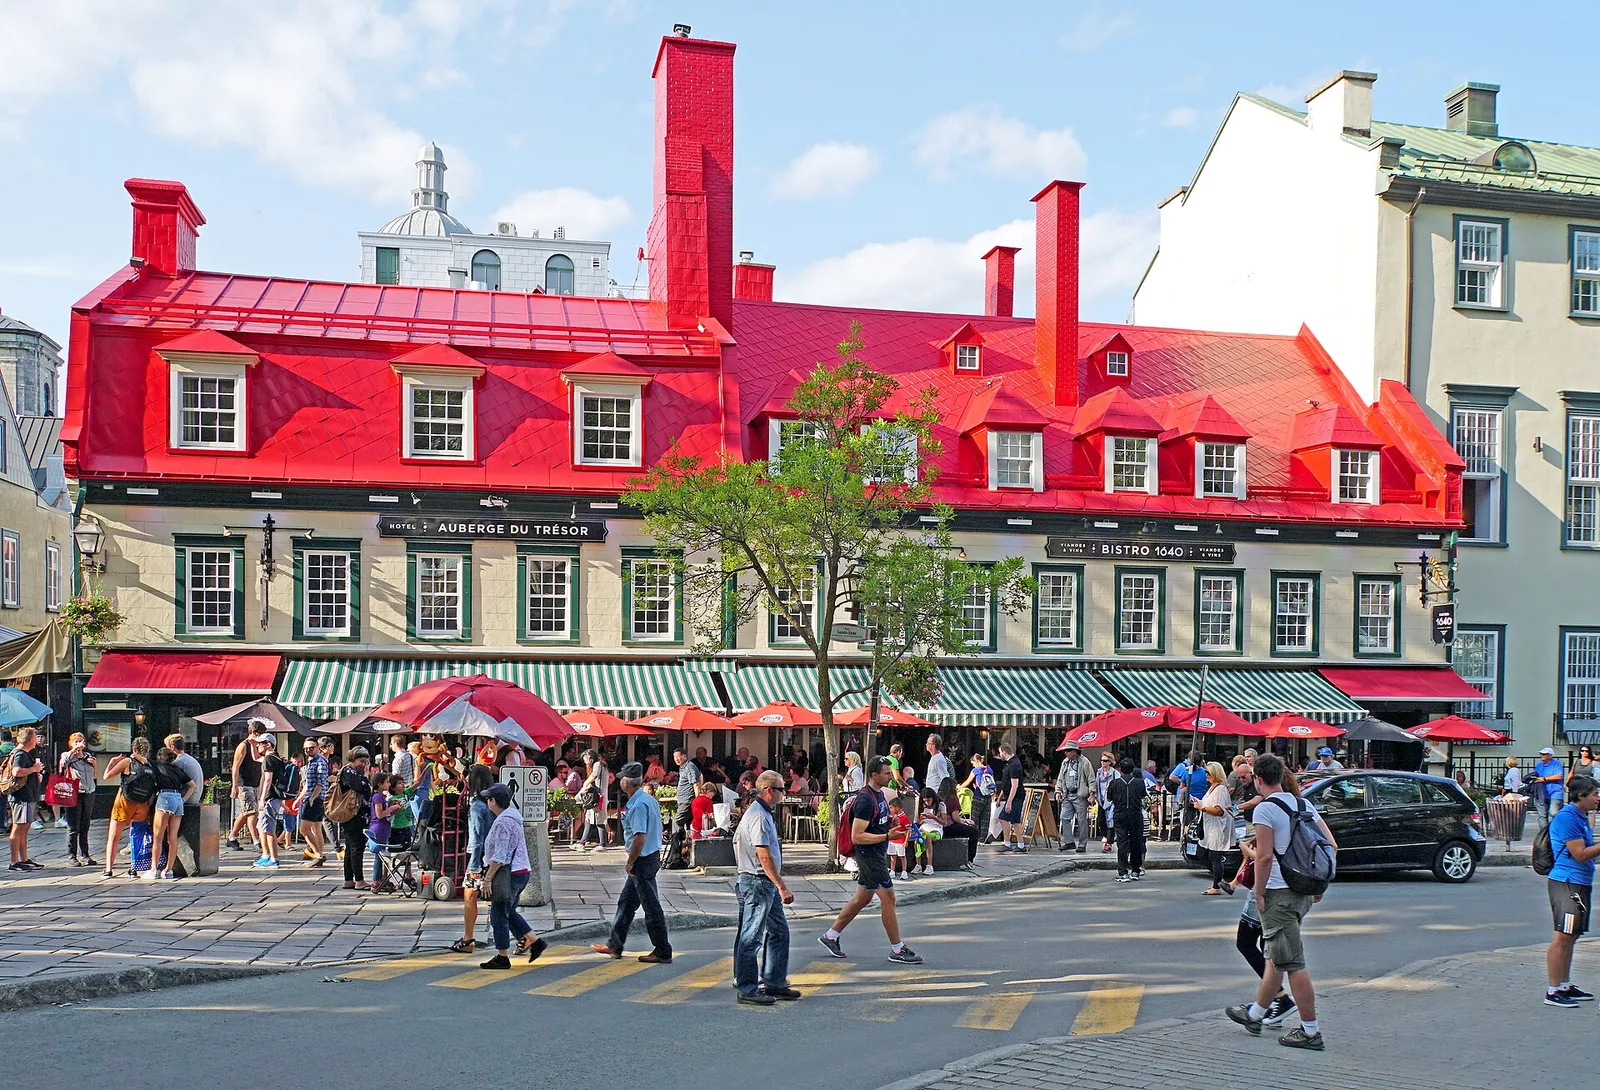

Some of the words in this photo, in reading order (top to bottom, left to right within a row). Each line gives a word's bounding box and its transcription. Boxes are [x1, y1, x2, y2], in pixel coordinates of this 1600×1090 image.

[437, 522, 505, 534] AUBERGE
[510, 525, 529, 535] DU
[533, 523, 589, 536] TRÉSOR
[1101, 544, 1150, 556] BISTRO
[1154, 546, 1184, 557] 1640
[1436, 617, 1453, 626] 1640
